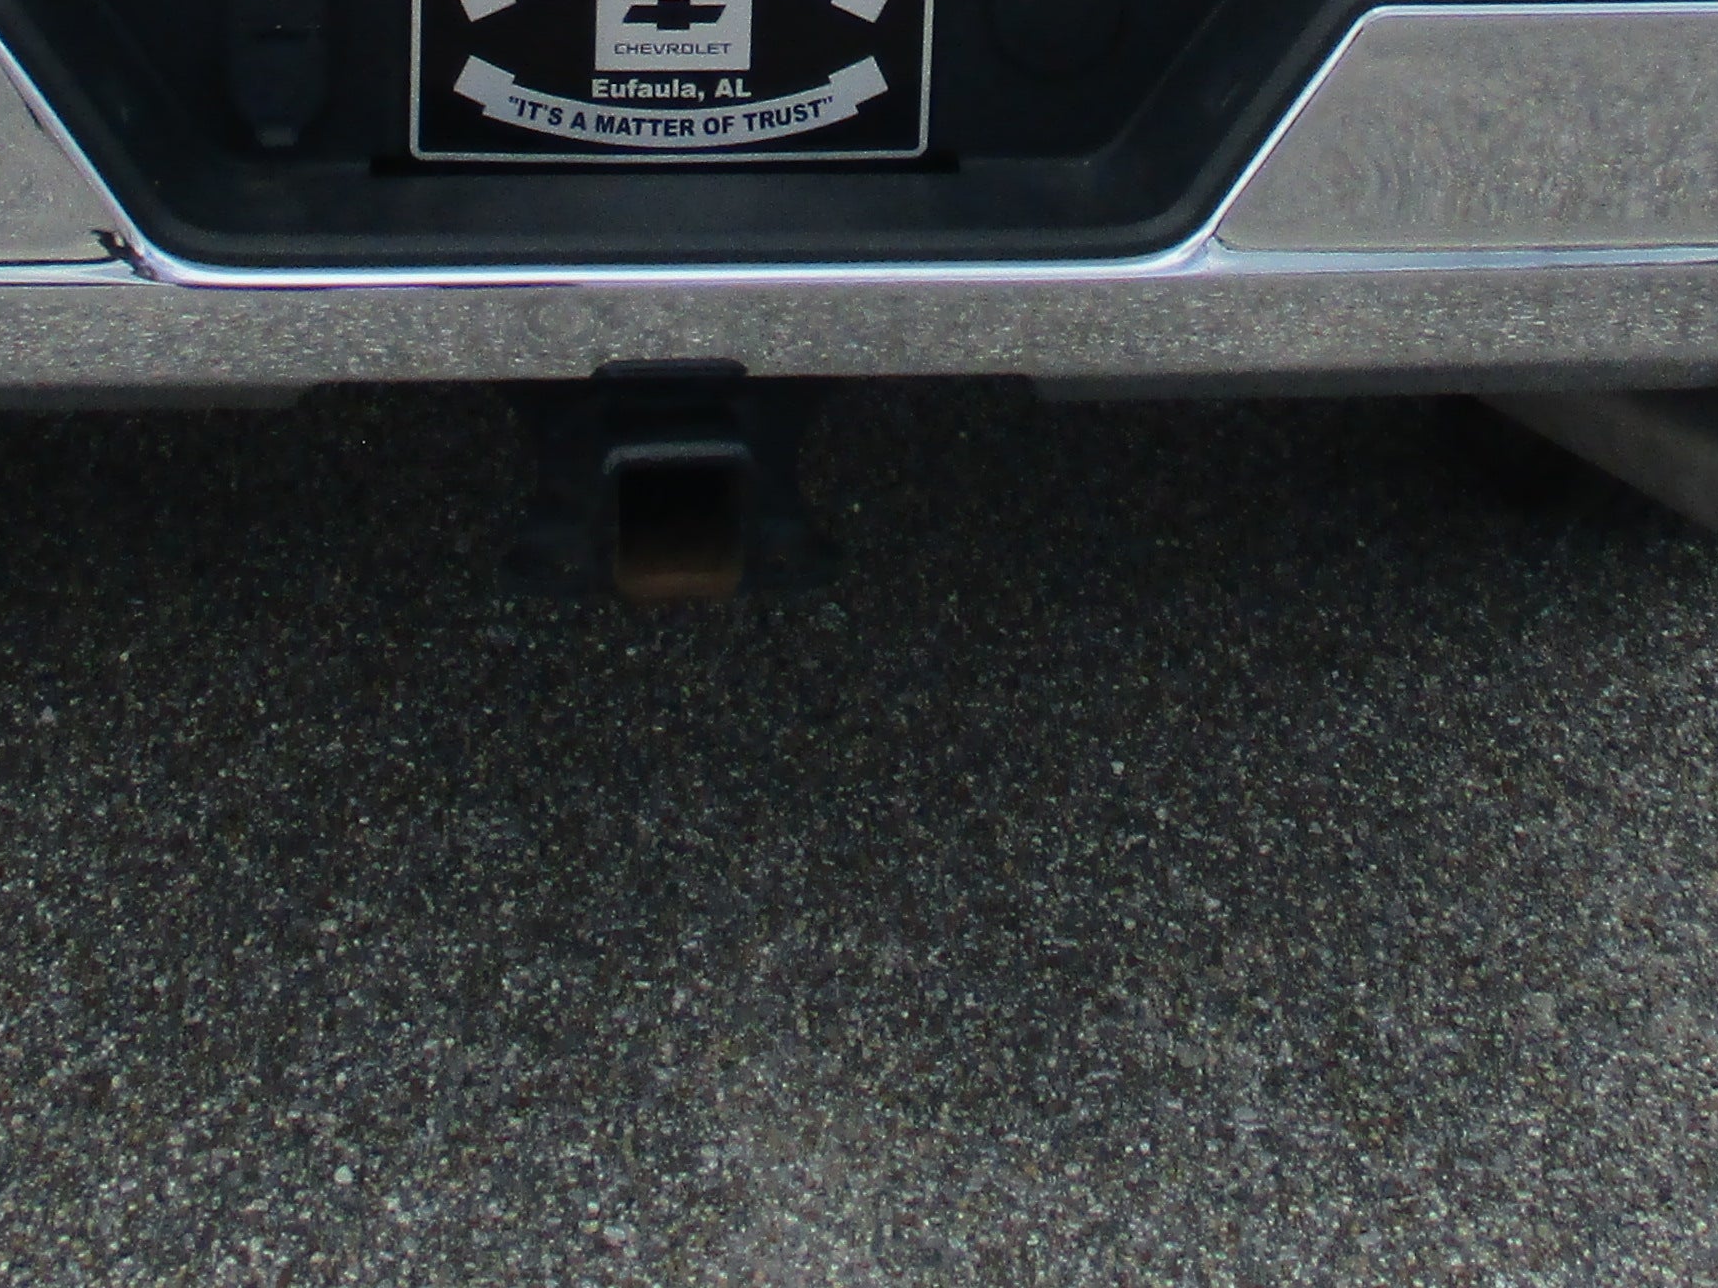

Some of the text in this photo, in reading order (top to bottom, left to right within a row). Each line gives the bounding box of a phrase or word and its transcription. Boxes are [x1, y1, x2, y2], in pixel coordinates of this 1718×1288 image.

[614, 42, 732, 55] CHEVROLET
[591, 78, 752, 102] Eufaula, AL
[508, 95, 835, 138] "IT'S A MATTER OF TRUST"
